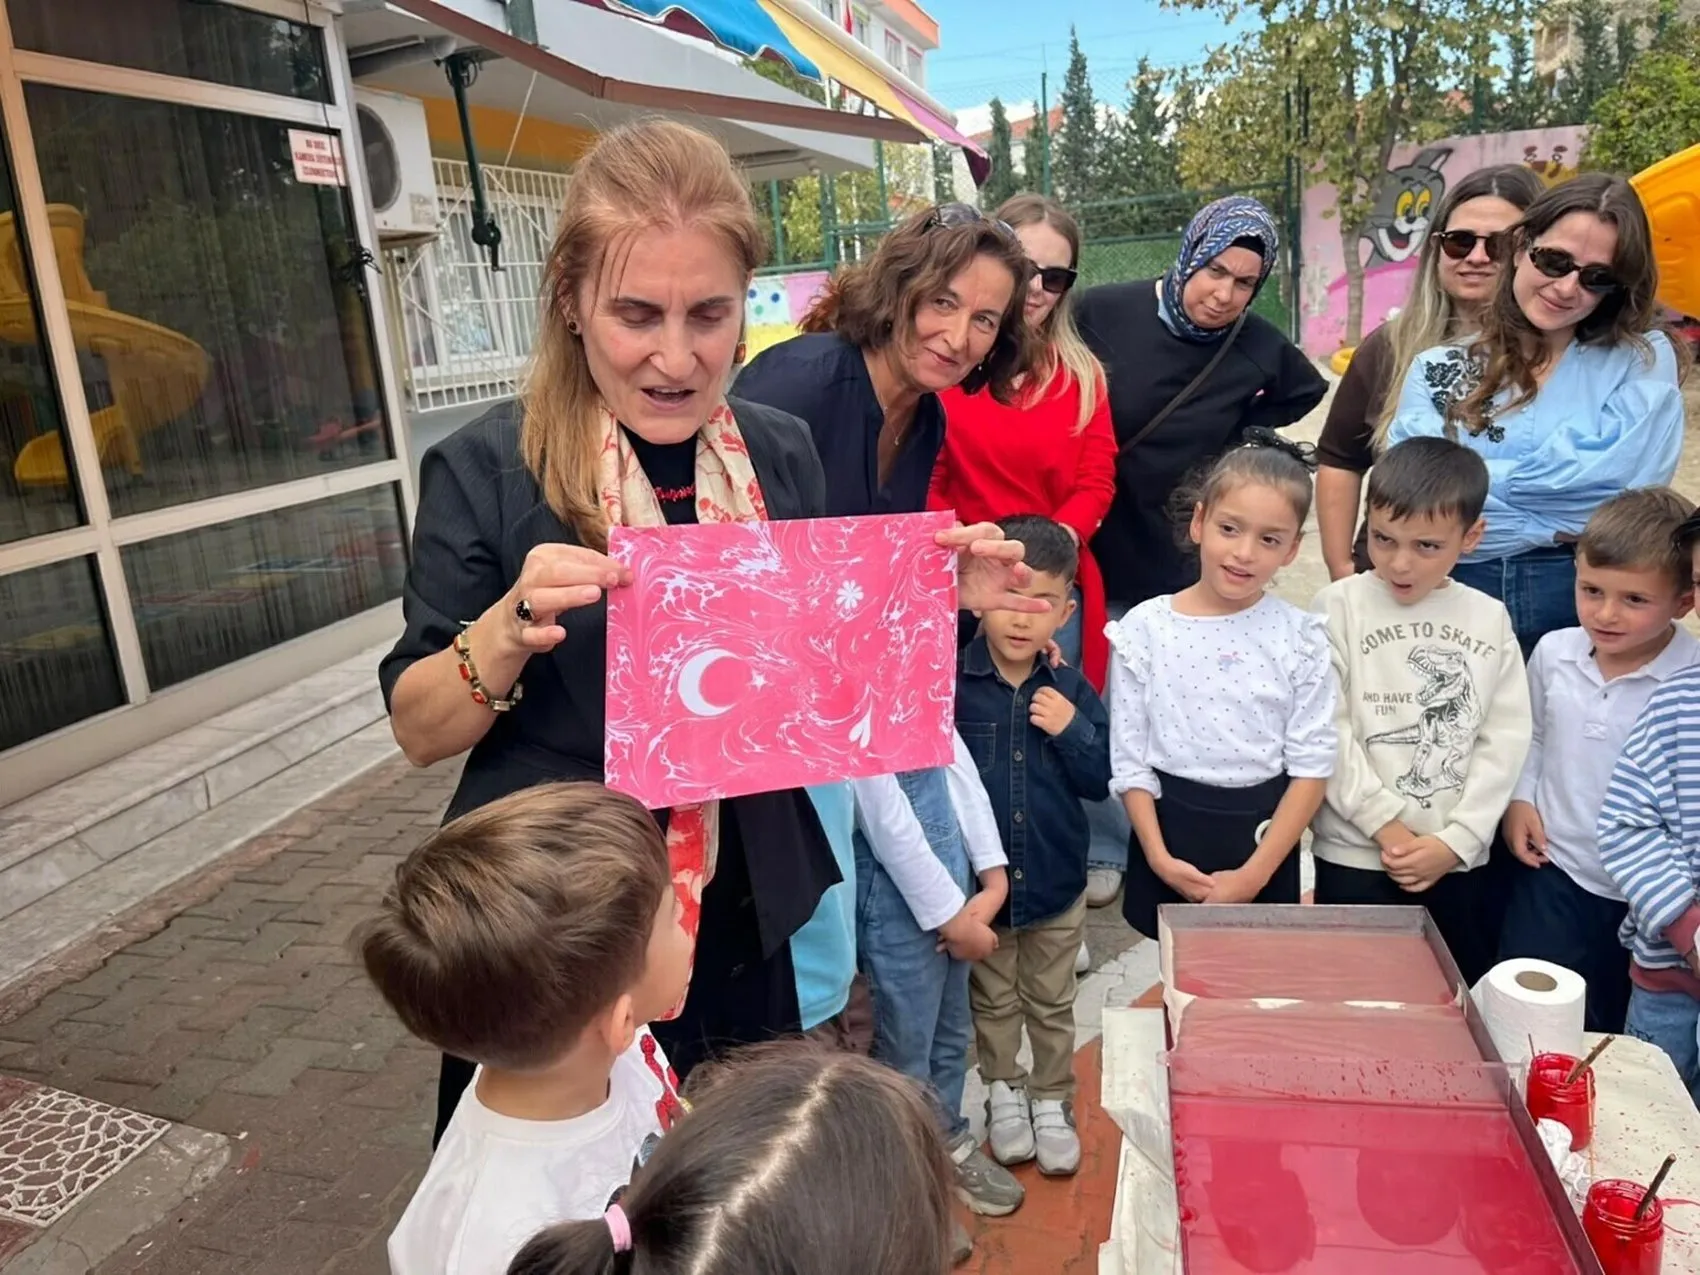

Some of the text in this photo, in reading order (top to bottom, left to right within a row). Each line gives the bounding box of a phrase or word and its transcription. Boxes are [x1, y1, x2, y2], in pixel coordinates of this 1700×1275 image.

[1360, 622, 1496, 660] COME TO SKATE
[1362, 691, 1413, 704] AND HAVE
[1375, 704, 1397, 716] FUN
